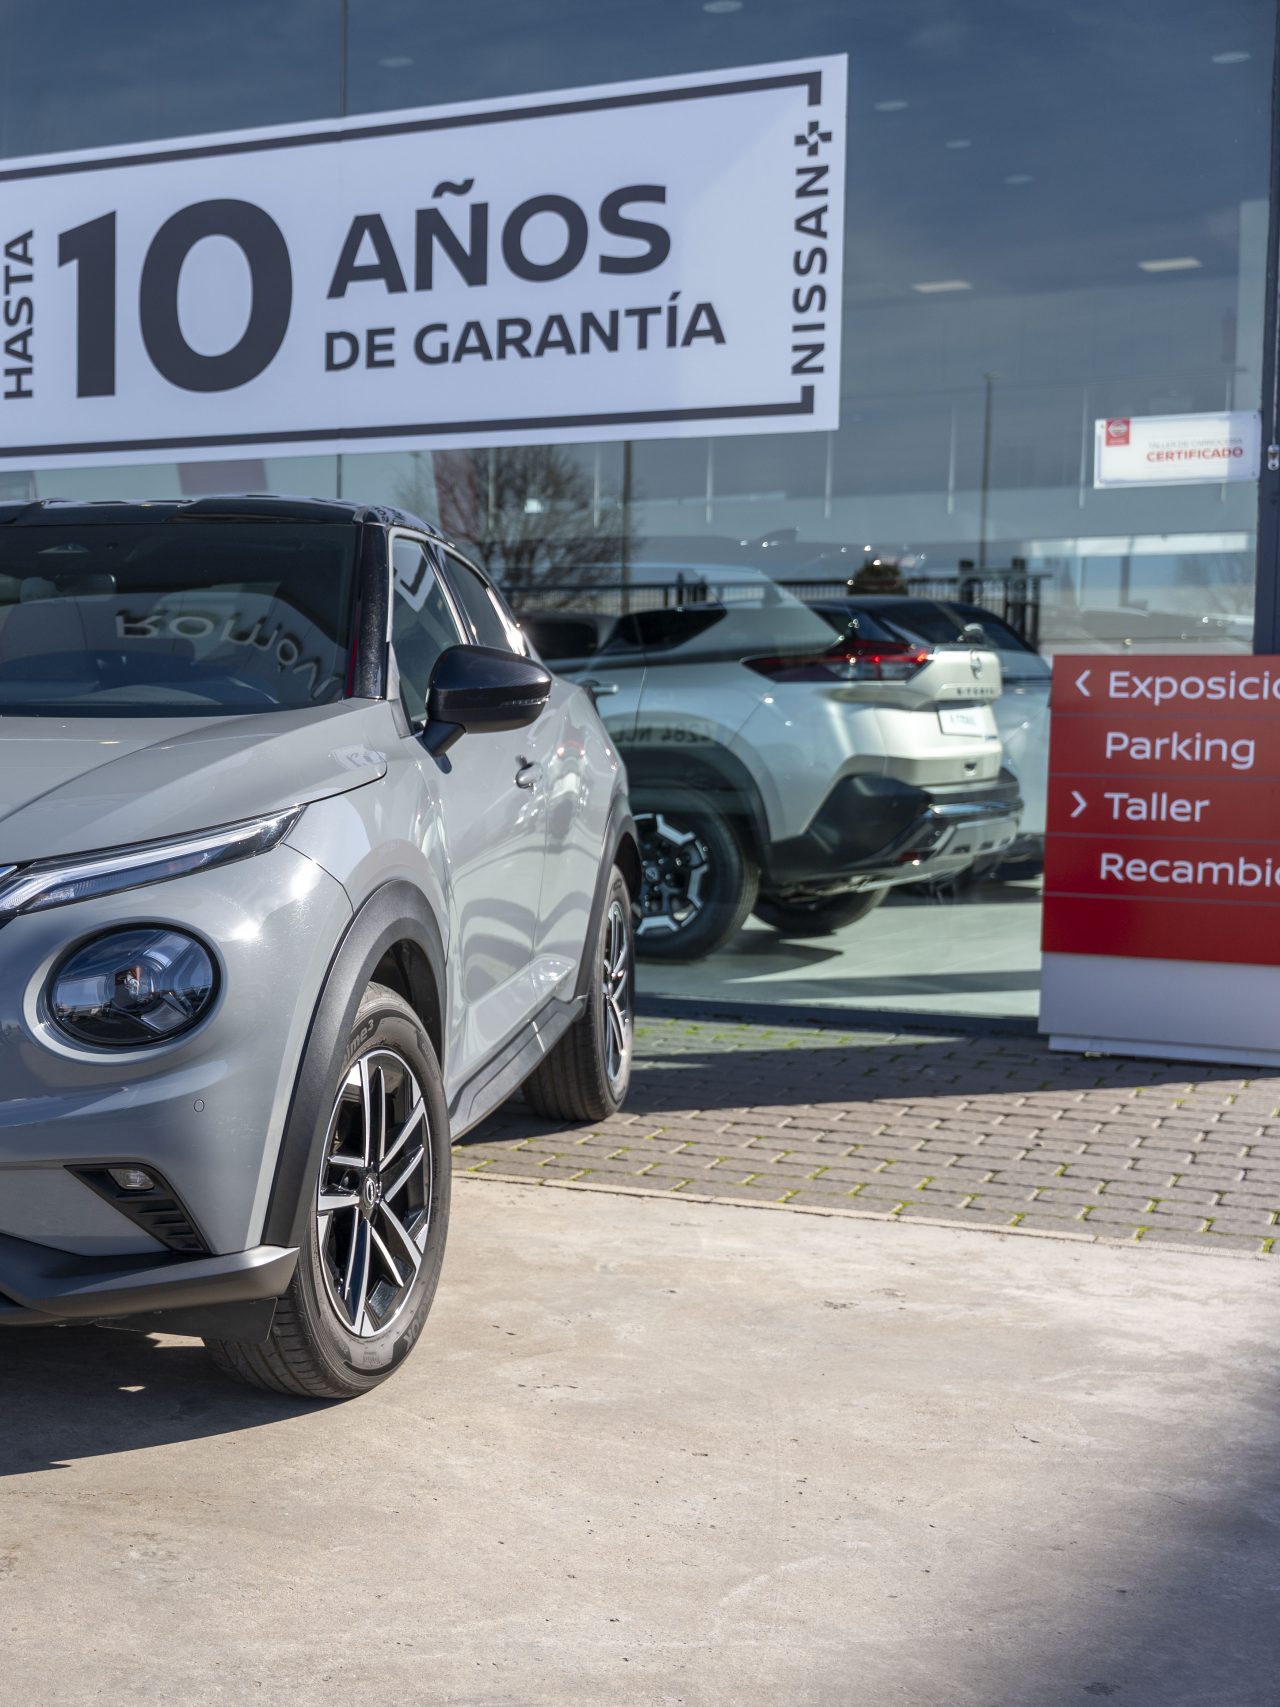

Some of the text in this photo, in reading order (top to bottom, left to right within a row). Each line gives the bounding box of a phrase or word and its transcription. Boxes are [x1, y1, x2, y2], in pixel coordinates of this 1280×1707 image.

[326, 178, 672, 299] AÑOS
[3, 229, 34, 400] HASTA
[57, 198, 293, 399] 10
[324, 292, 727, 373] DE GARANTÍA
[1146, 446, 1244, 462] CERTIFICADO
[1105, 731, 1256, 770] Parking
[1103, 791, 1210, 822] Taller
[1100, 852, 1280, 887] Recambi
